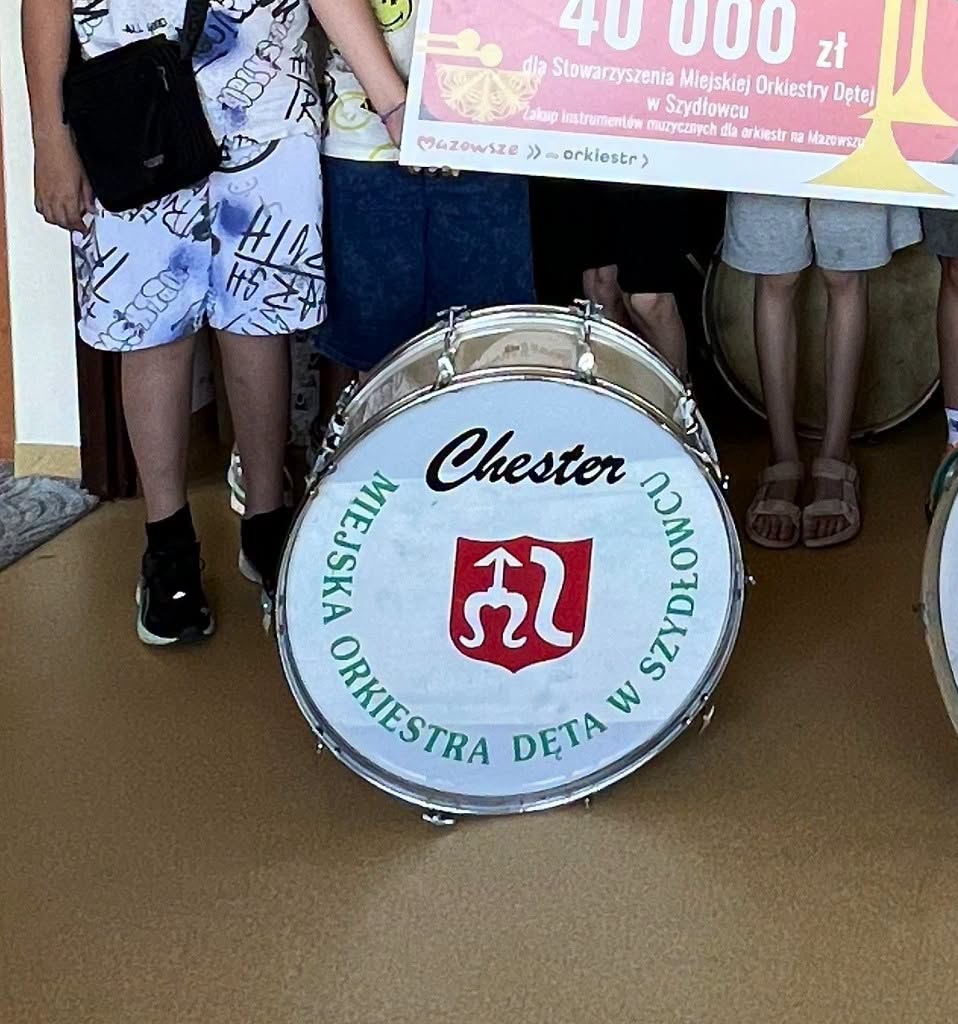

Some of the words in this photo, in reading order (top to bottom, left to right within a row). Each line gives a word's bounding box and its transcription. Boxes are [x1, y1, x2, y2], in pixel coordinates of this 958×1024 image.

[815, 32, 848, 69] zł
[522, 55, 547, 77] dla
[552, 56, 674, 86] Stowarzyszenia
[680, 67, 750, 96] Miejskiej
[756, 74, 829, 103] Orkiestry
[833, 81, 875, 106] Dętej
[647, 97, 661, 111] w
[665, 93, 749, 119] Szydłowcu
[522, 105, 558, 125] Zakup
[561, 108, 643, 129] instrumentów
[646, 118, 717, 138] muzycznych
[720, 122, 737, 137] dla
[741, 126, 786, 143] orkiestr
[790, 131, 804, 144] na
[564, 146, 637, 166] orkiestr
[425, 427, 627, 492] Chester
[322, 470, 400, 625] MIEJSKA
[640, 471, 699, 682] SZYDŁOWCU
[330, 636, 490, 766] ORKIESTRA
[607, 681, 641, 715] W
[513, 712, 608, 763] DĘTA
